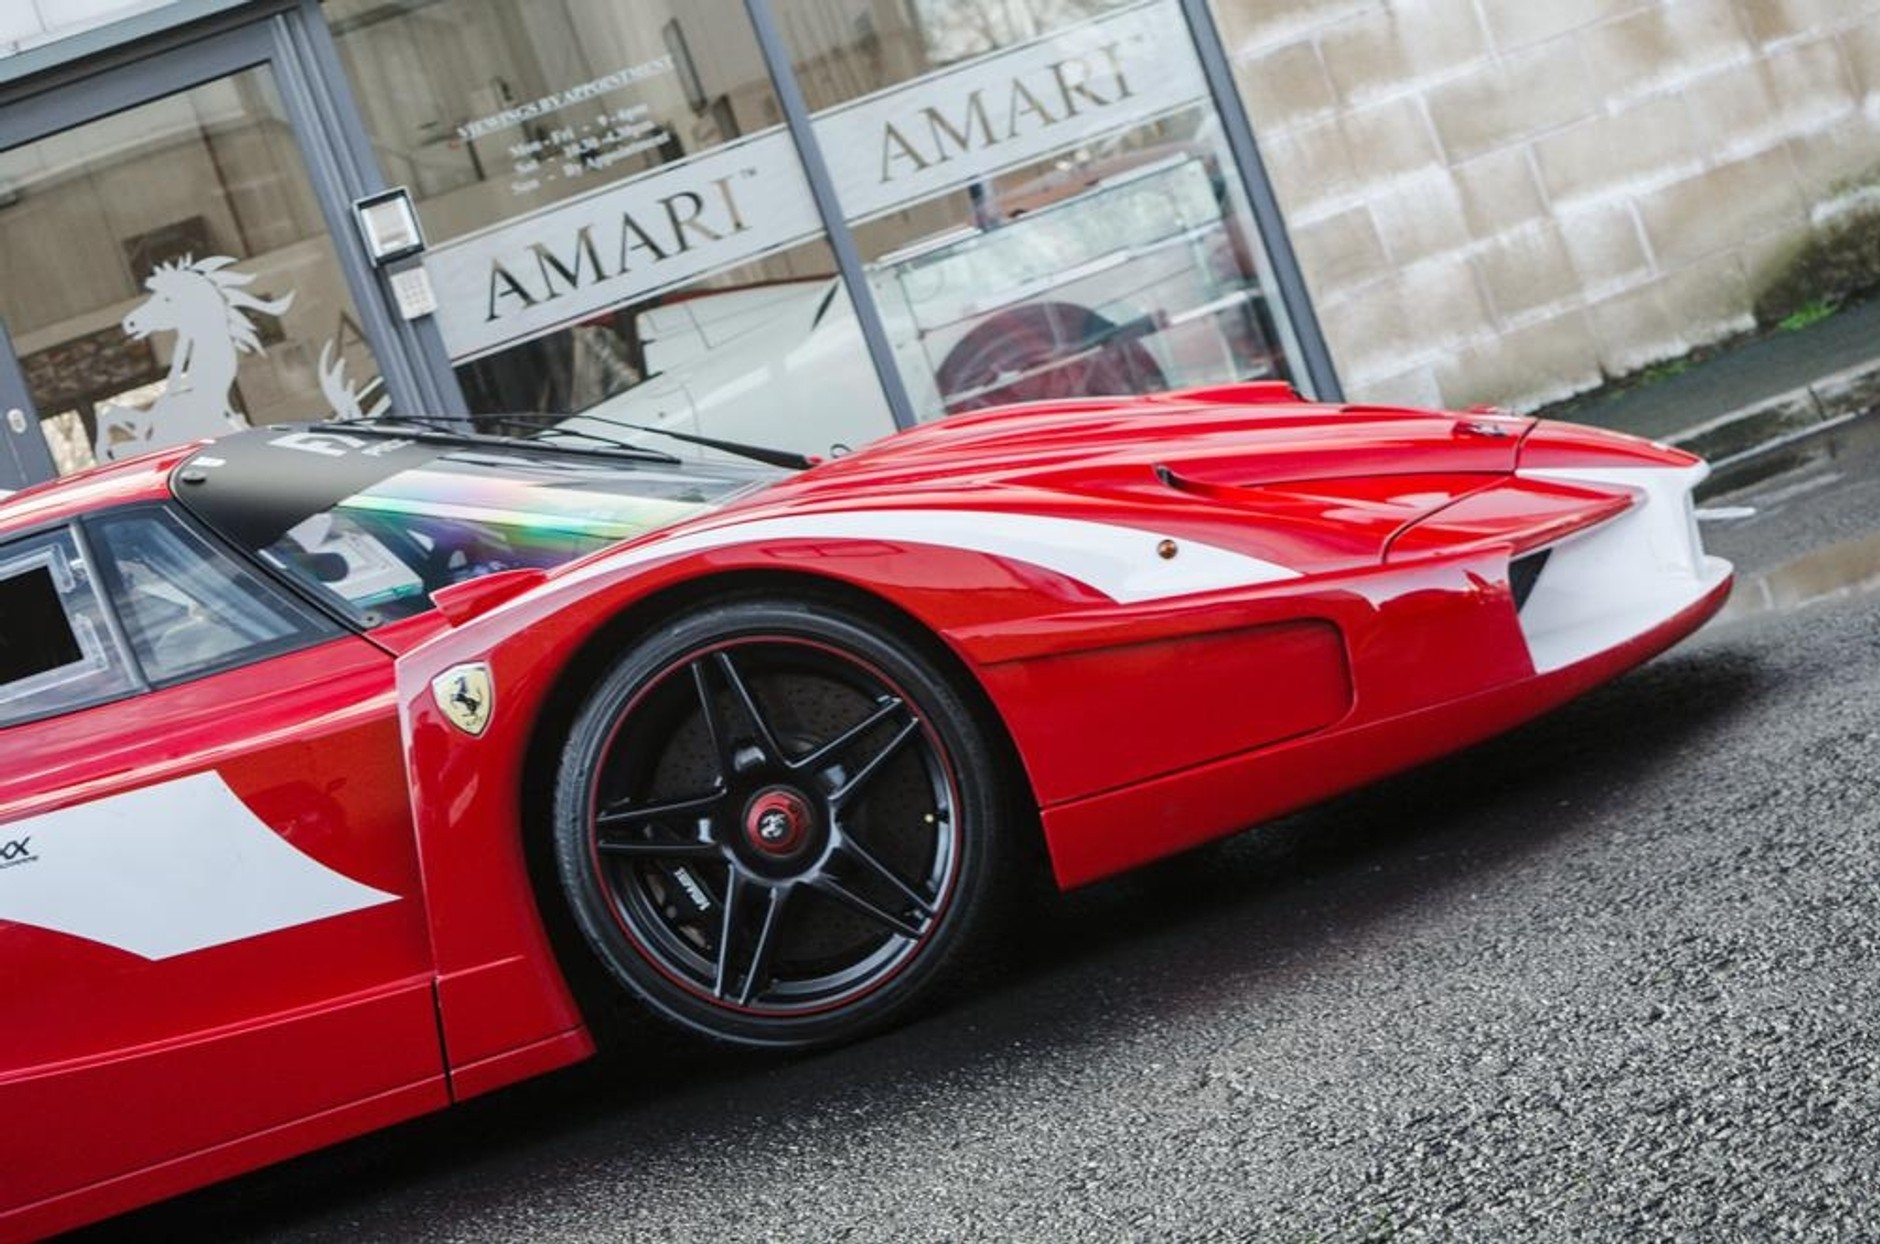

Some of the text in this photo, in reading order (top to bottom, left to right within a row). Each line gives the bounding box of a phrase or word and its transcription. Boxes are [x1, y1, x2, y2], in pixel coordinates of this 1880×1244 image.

[456, 54, 676, 141] VIEWINGS BY APPOINTMENT
[551, 126, 576, 146] Fri
[879, 42, 1135, 183] AMARI
[485, 175, 752, 323] AMARI
